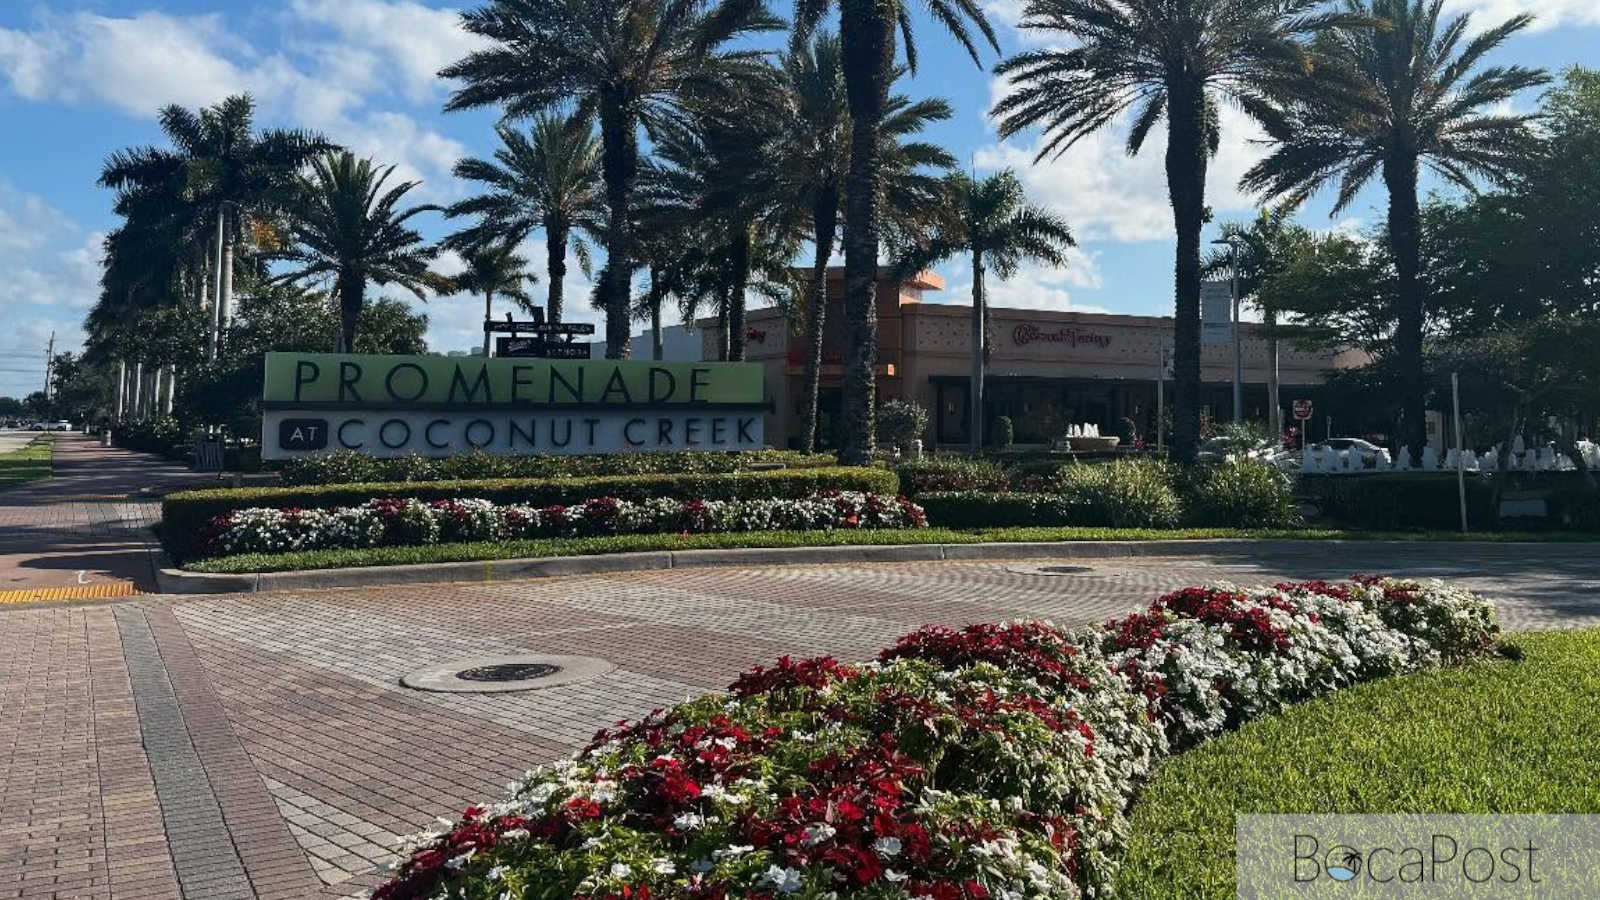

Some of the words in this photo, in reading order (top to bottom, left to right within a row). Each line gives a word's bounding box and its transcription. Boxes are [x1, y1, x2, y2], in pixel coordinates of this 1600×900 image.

[295, 361, 711, 402] PROMENADE
[290, 426, 318, 441] AT
[338, 418, 600, 449] COCONUT
[624, 417, 755, 446] CREEK
